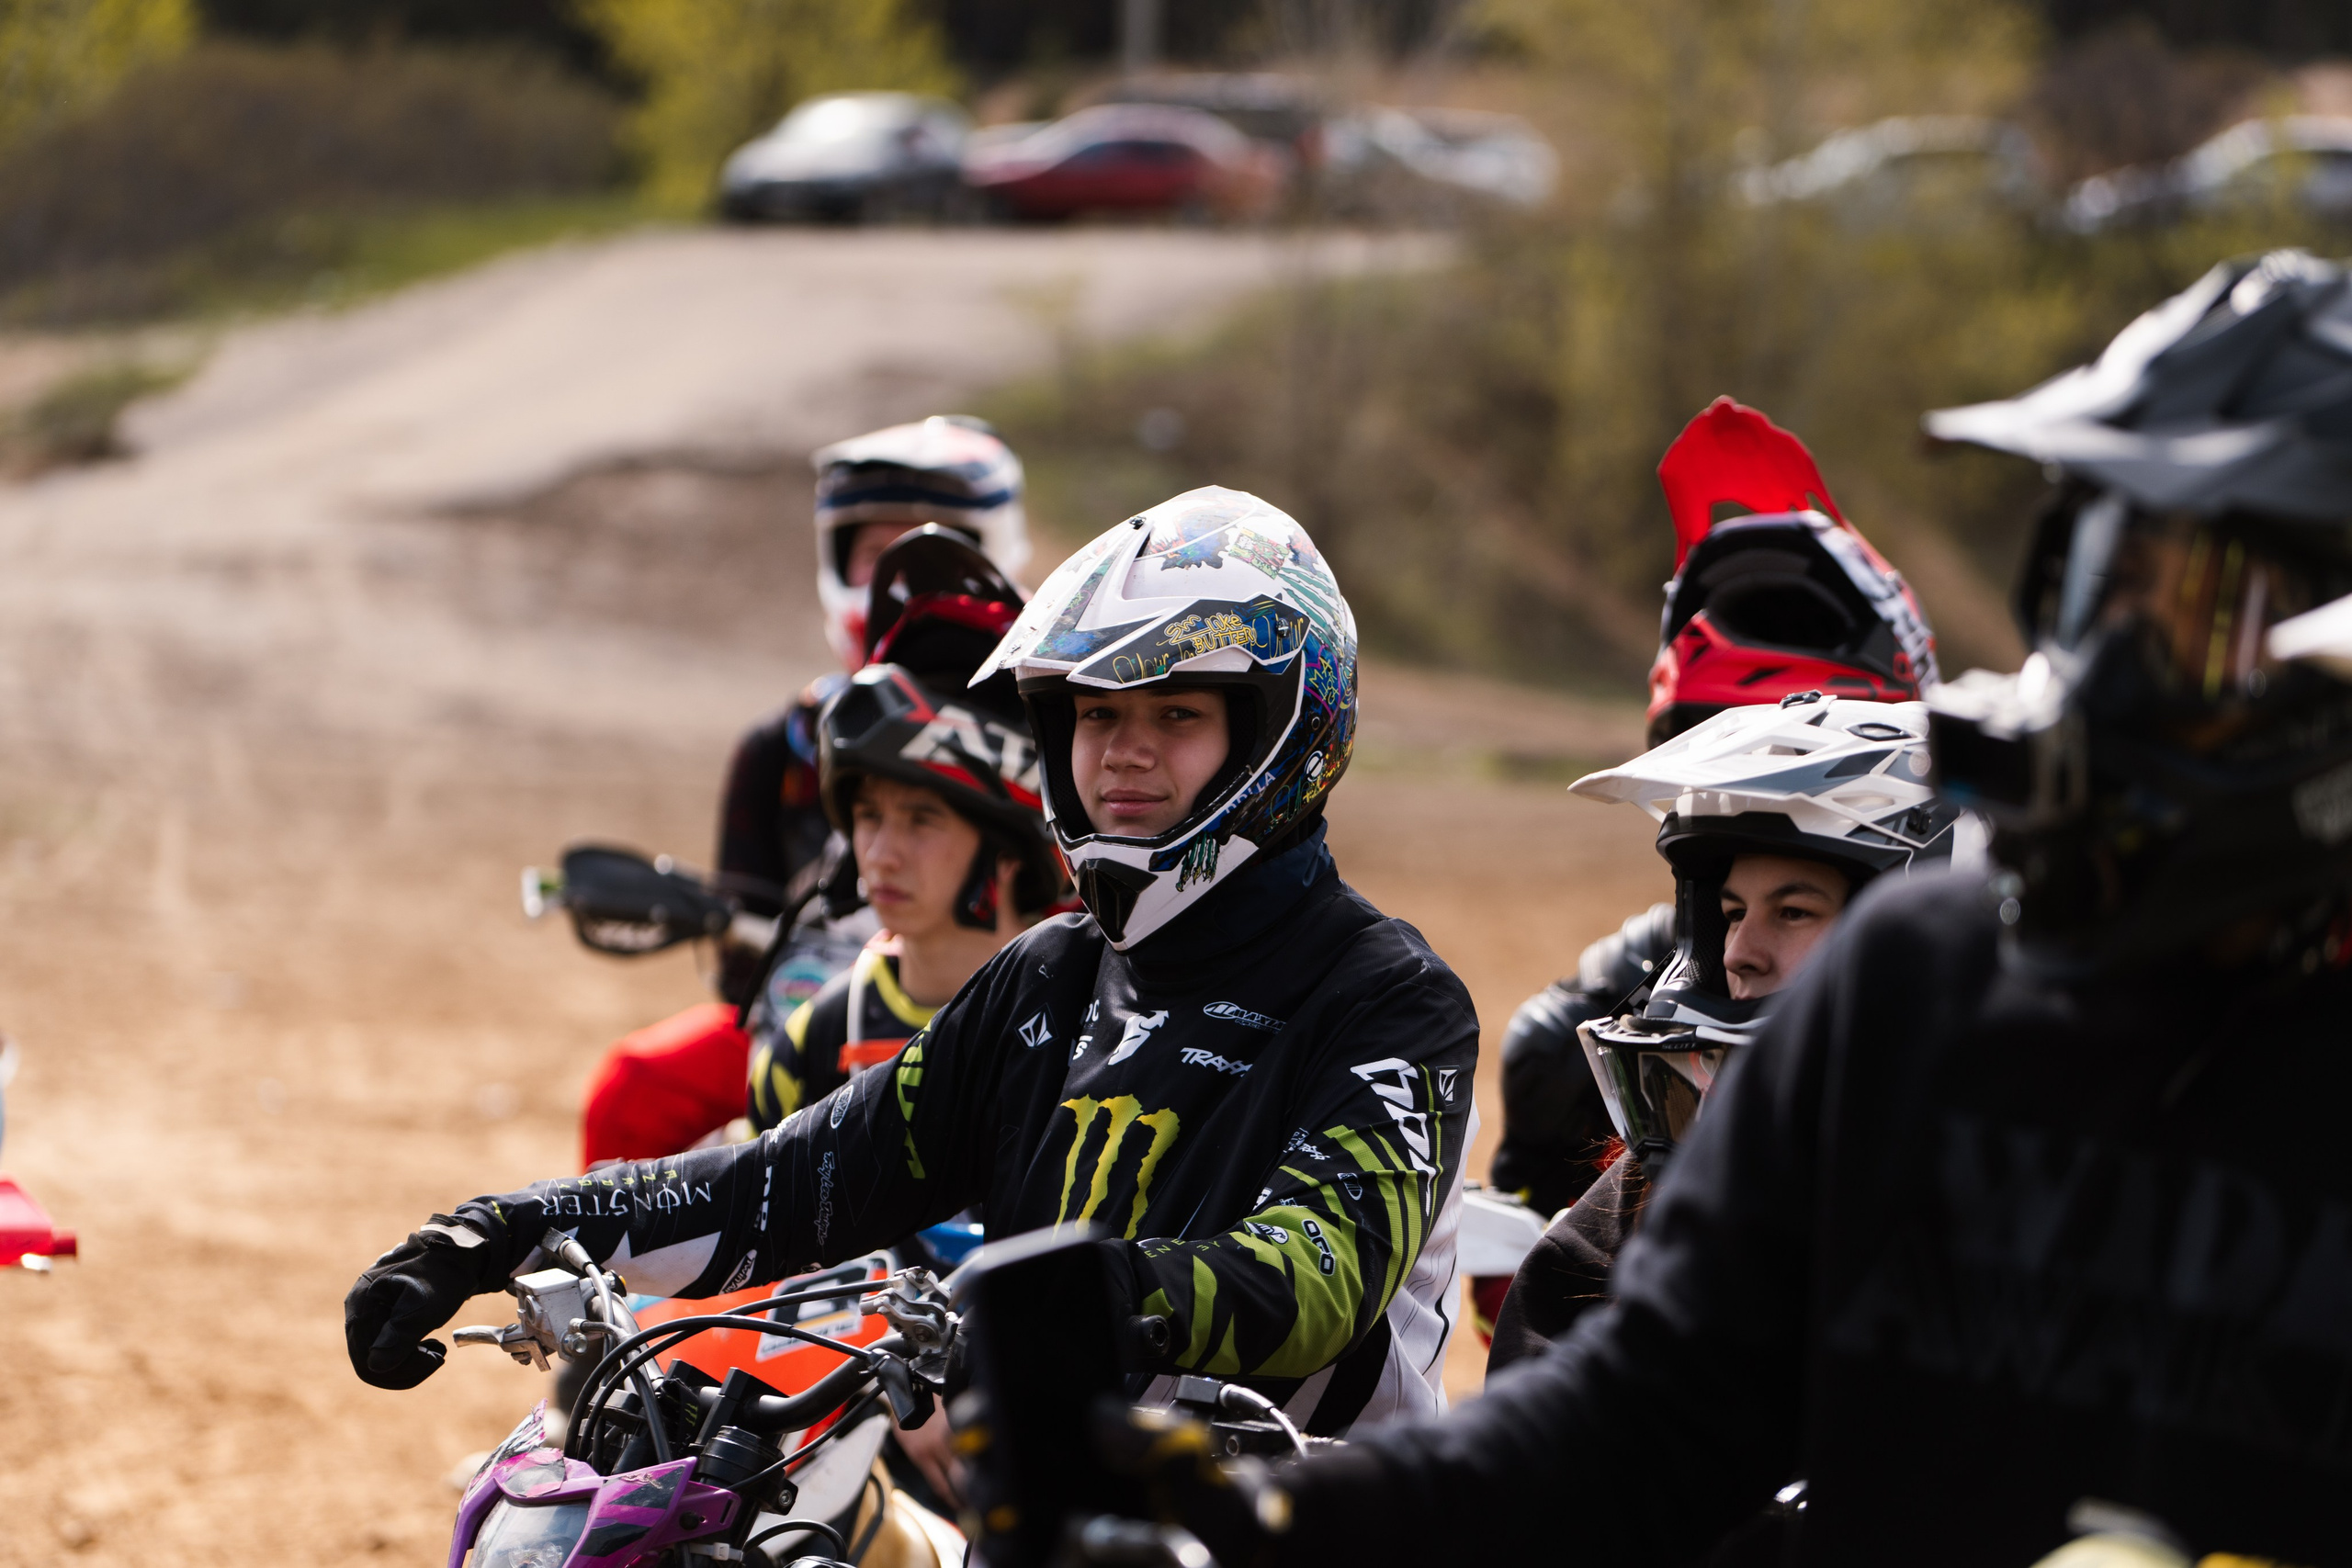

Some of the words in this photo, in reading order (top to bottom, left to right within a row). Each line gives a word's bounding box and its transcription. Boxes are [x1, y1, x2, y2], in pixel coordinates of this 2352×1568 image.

[1193, 624, 1254, 657] BUTTER
[899, 704, 1043, 792] AT
[559, 1169, 678, 1189] ENERGY
[532, 1181, 711, 1218] MONSTER
